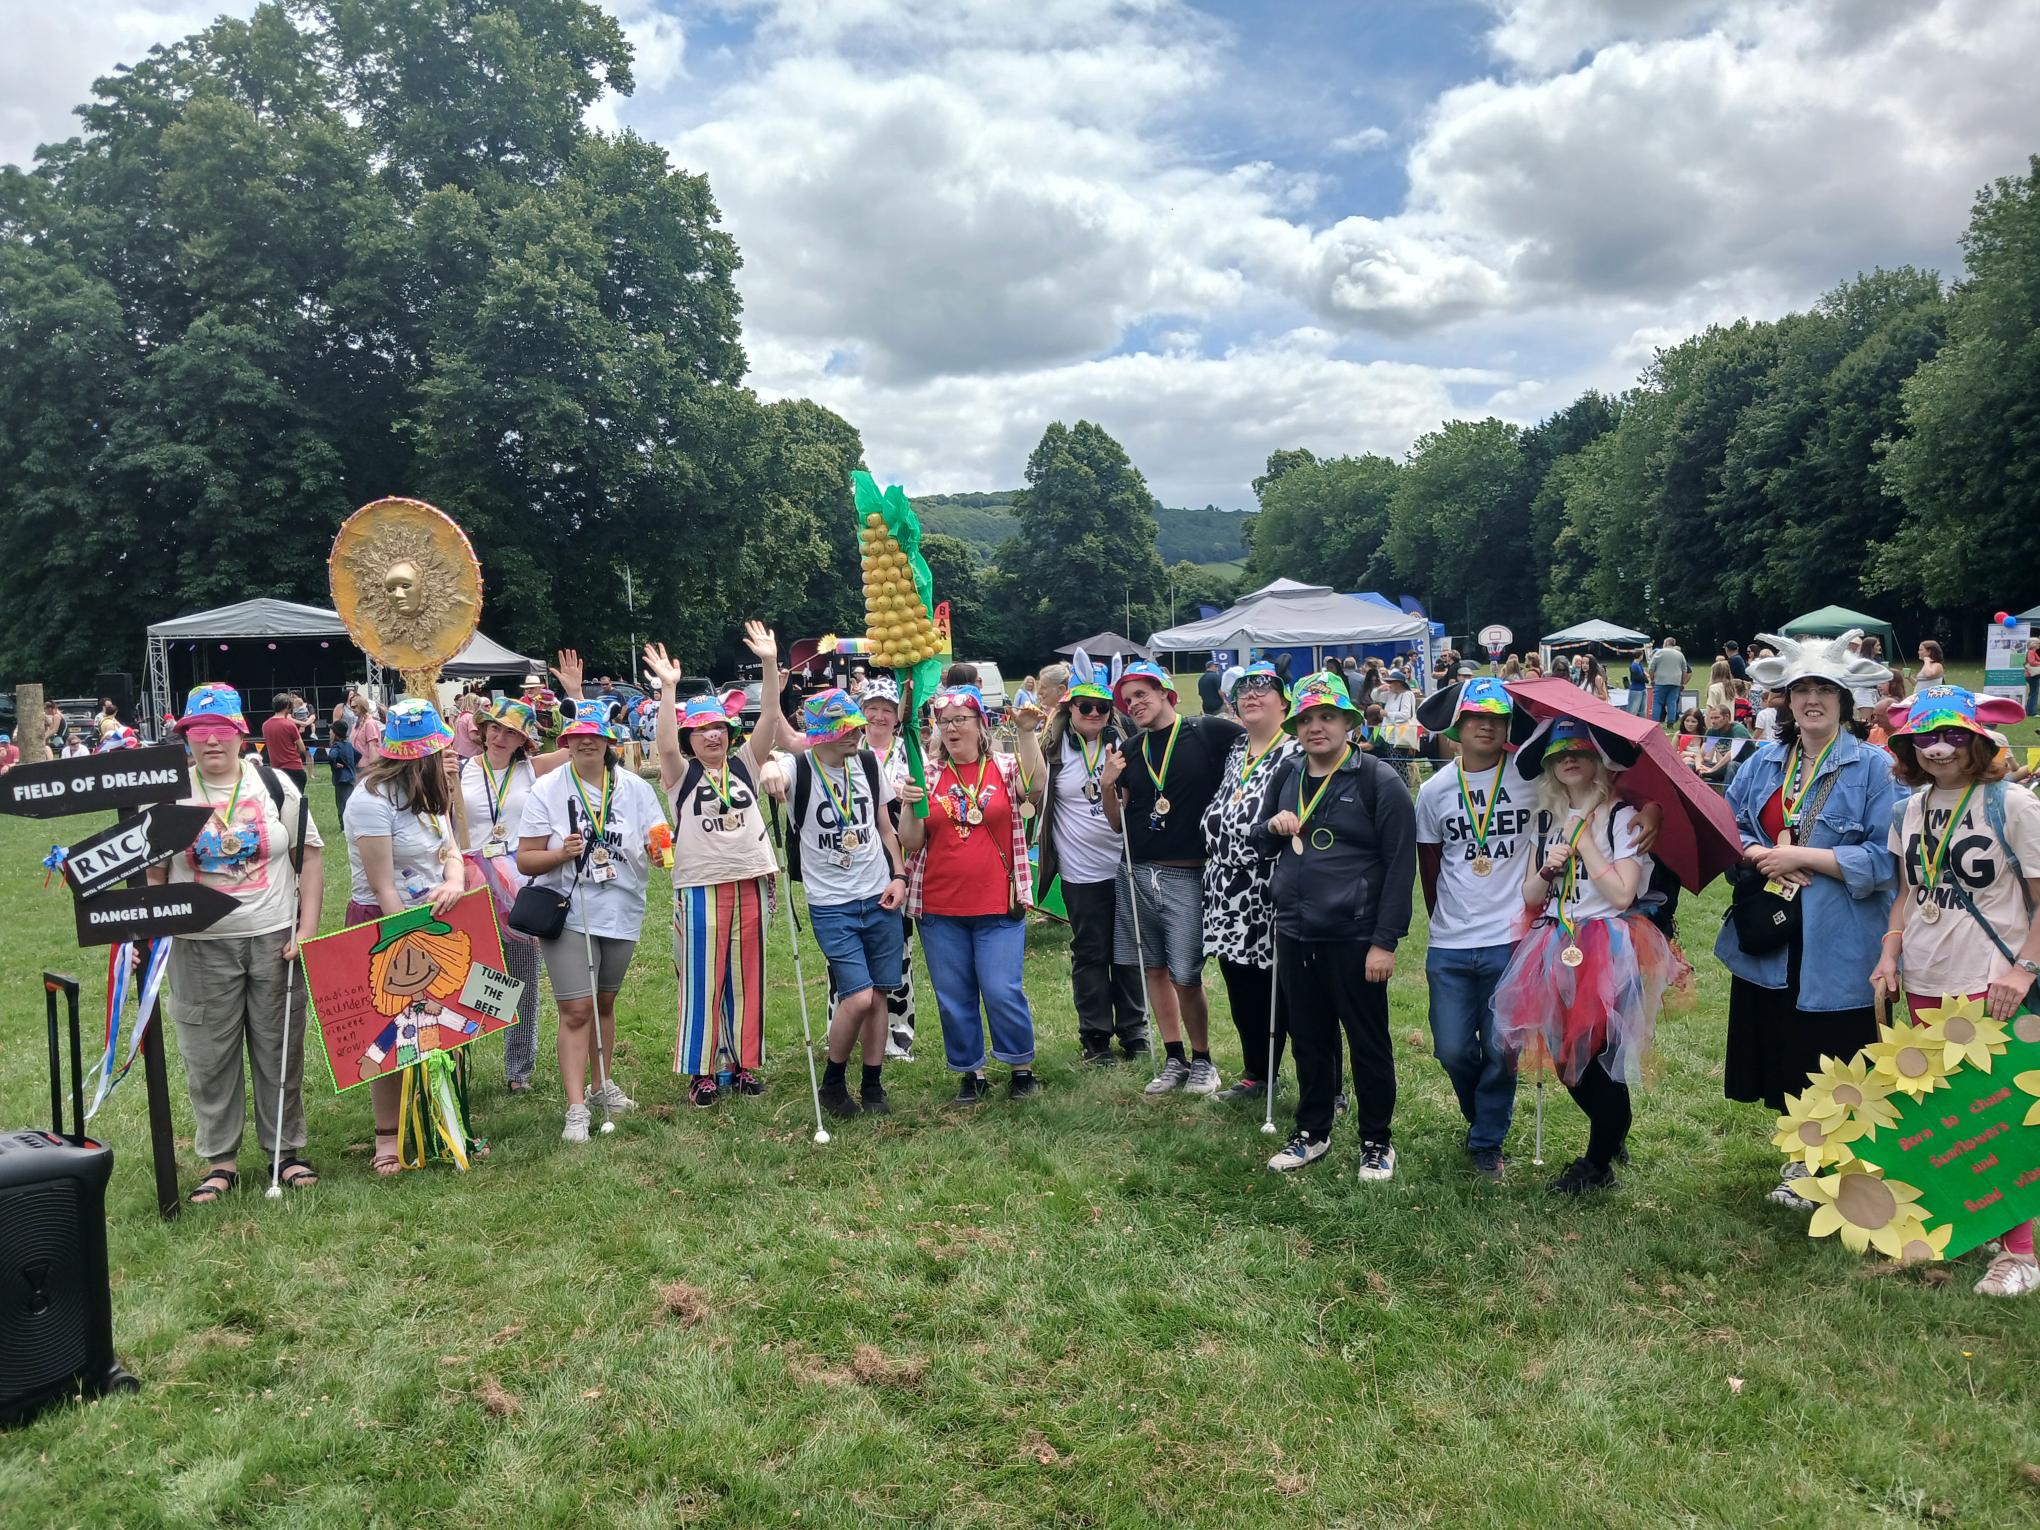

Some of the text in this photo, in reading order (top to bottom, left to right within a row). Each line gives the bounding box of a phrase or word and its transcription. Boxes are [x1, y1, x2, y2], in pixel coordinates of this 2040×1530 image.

[938, 605, 947, 641] BAR
[13, 768, 179, 802] FIELD OF DREAMS
[1496, 787, 1512, 810] A
[1446, 809, 1531, 841] SHEEP
[1958, 809, 1974, 830] A
[819, 828, 871, 850] MEW!
[1464, 840, 1515, 861] BAA!
[74, 833, 144, 879] RNC
[120, 866, 141, 878] COLLEGE
[139, 861, 150, 869] FOR
[149, 856, 160, 865] THE
[90, 903, 193, 924] DANGER BARN
[481, 966, 520, 989] TURNIP
[484, 985, 505, 1001] THE
[474, 1000, 501, 1017] BEET
[1929, 1121, 2011, 1169] Sunflowers
[1971, 1152, 1999, 1175] and
